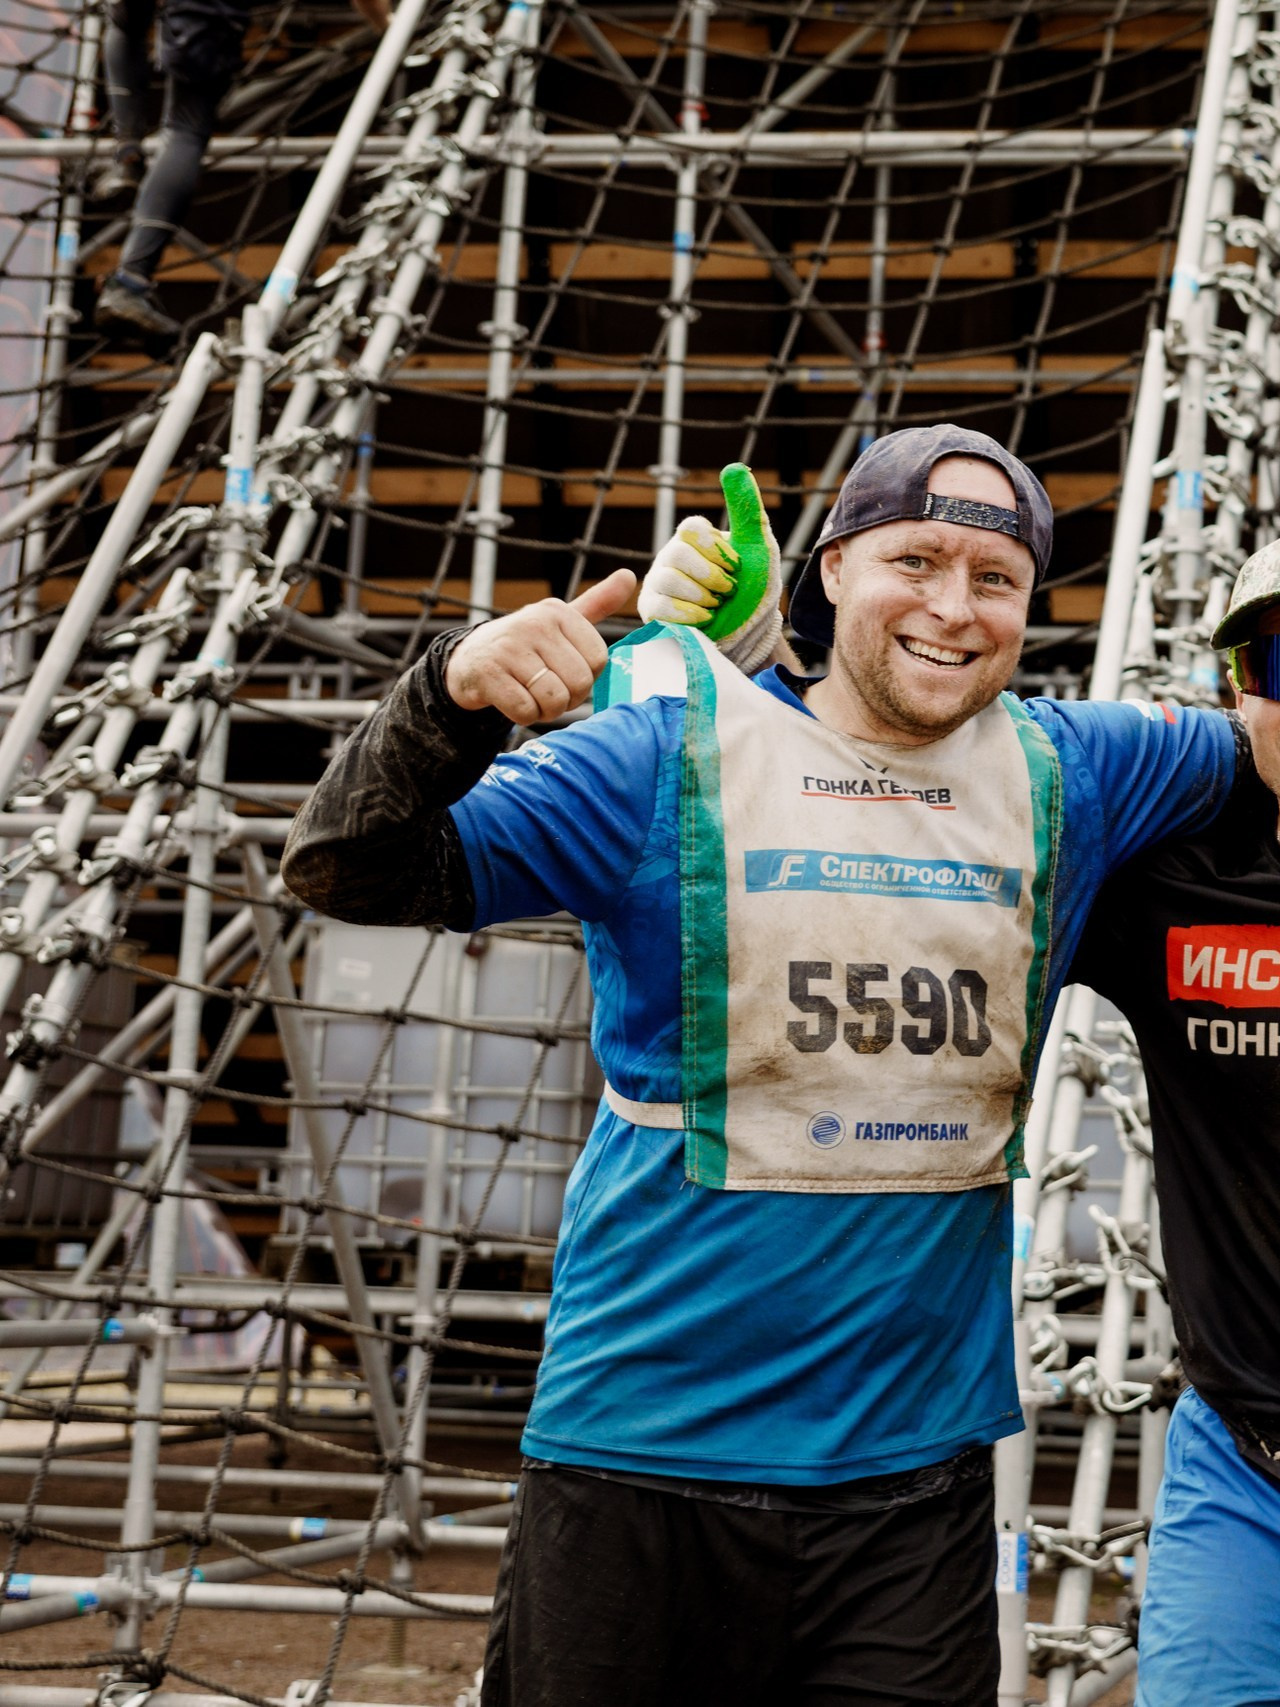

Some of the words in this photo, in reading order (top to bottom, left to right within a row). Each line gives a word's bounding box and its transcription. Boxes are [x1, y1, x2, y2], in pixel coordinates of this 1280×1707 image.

[803, 776, 874, 795] ГОНКА
[877, 779, 951, 804] ГЕОЕВ
[931, 887, 998, 899] ОТВЕТСТВЕННО
[786, 960, 992, 1058] 5590
[855, 1122, 969, 1141] ГАЗПРОМБАНК
